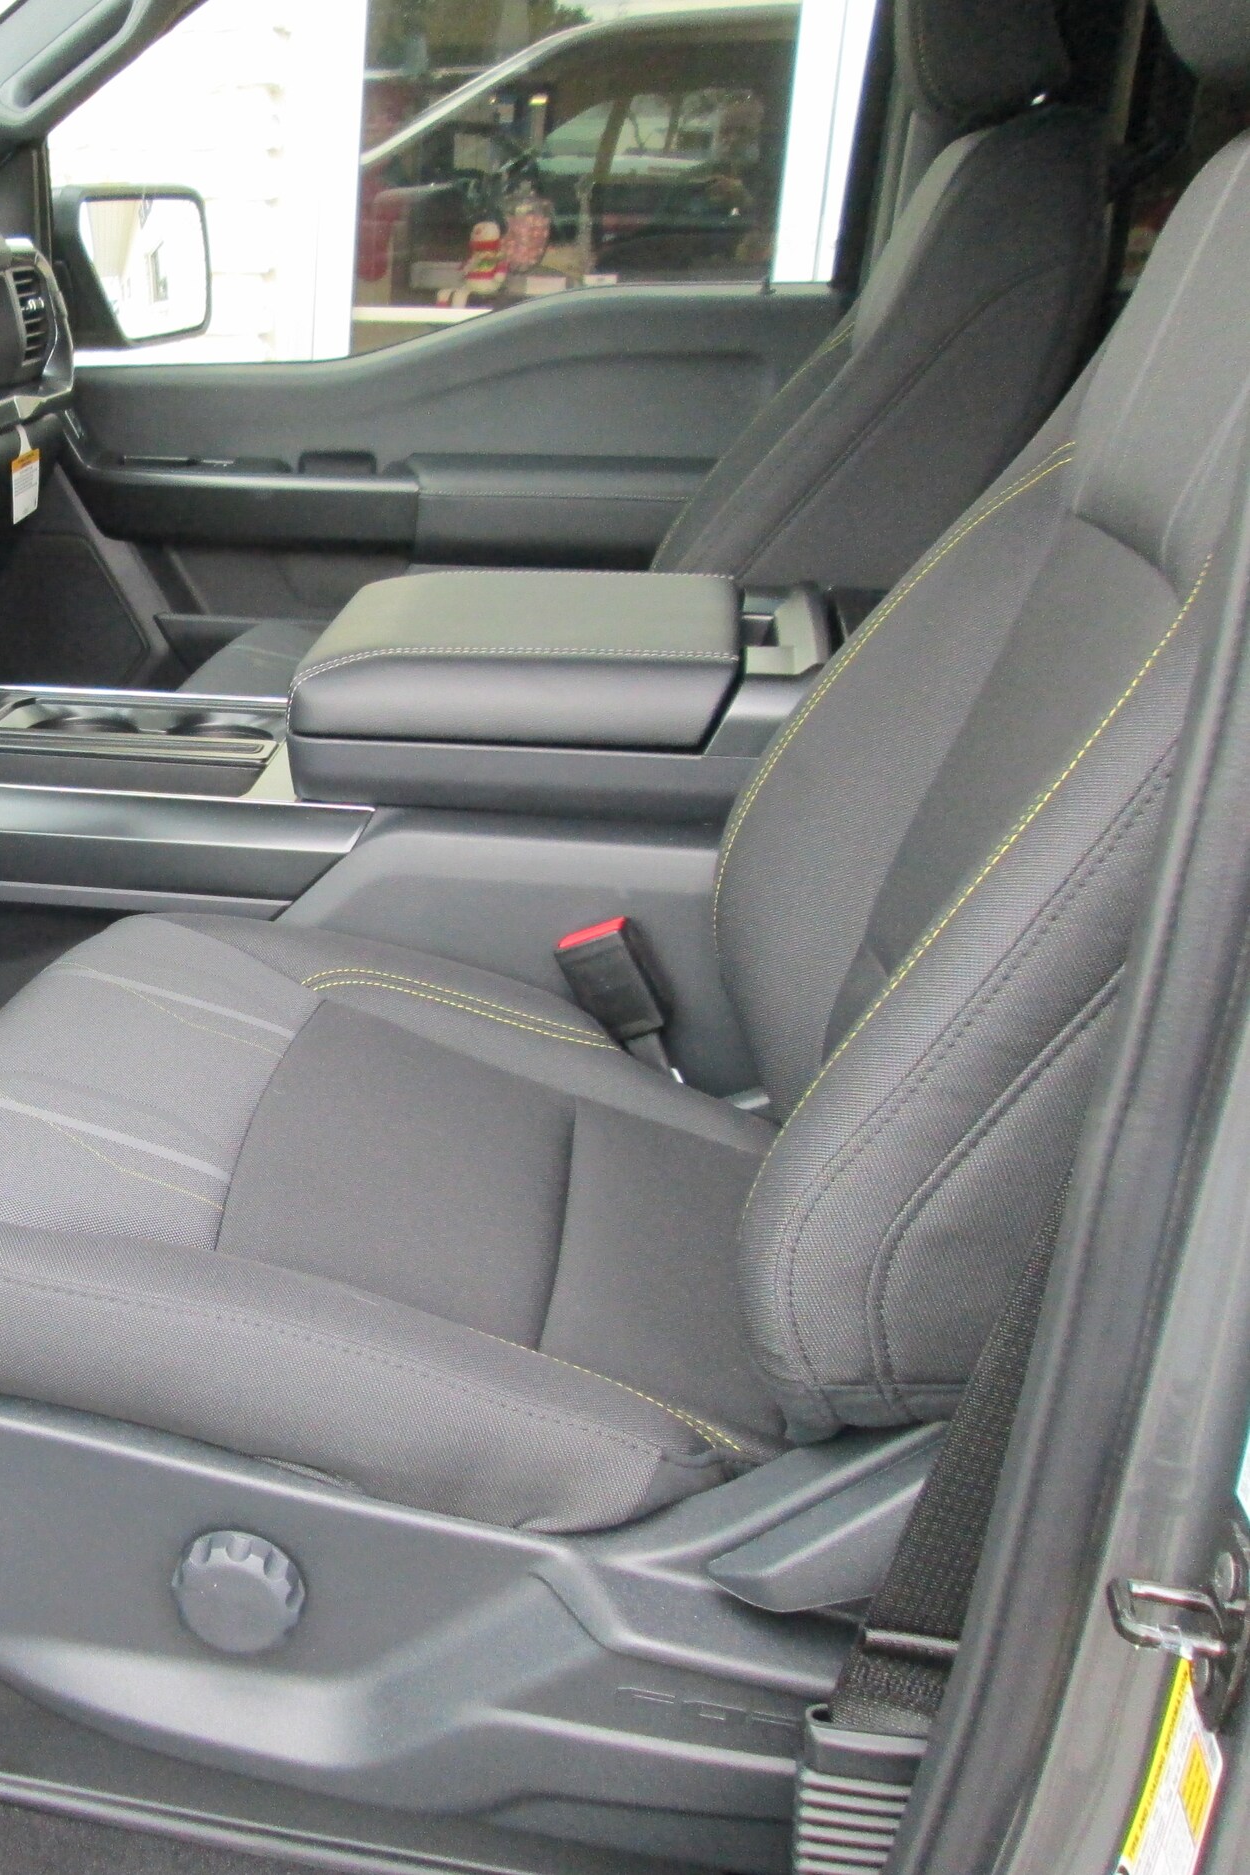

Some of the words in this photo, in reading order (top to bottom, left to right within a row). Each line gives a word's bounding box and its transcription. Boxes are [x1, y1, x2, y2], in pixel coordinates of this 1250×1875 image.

[1137, 1807, 1149, 1830] AND
[1146, 1755, 1166, 1806] LOADING
[1162, 1669, 1189, 1752] INFORMATION
